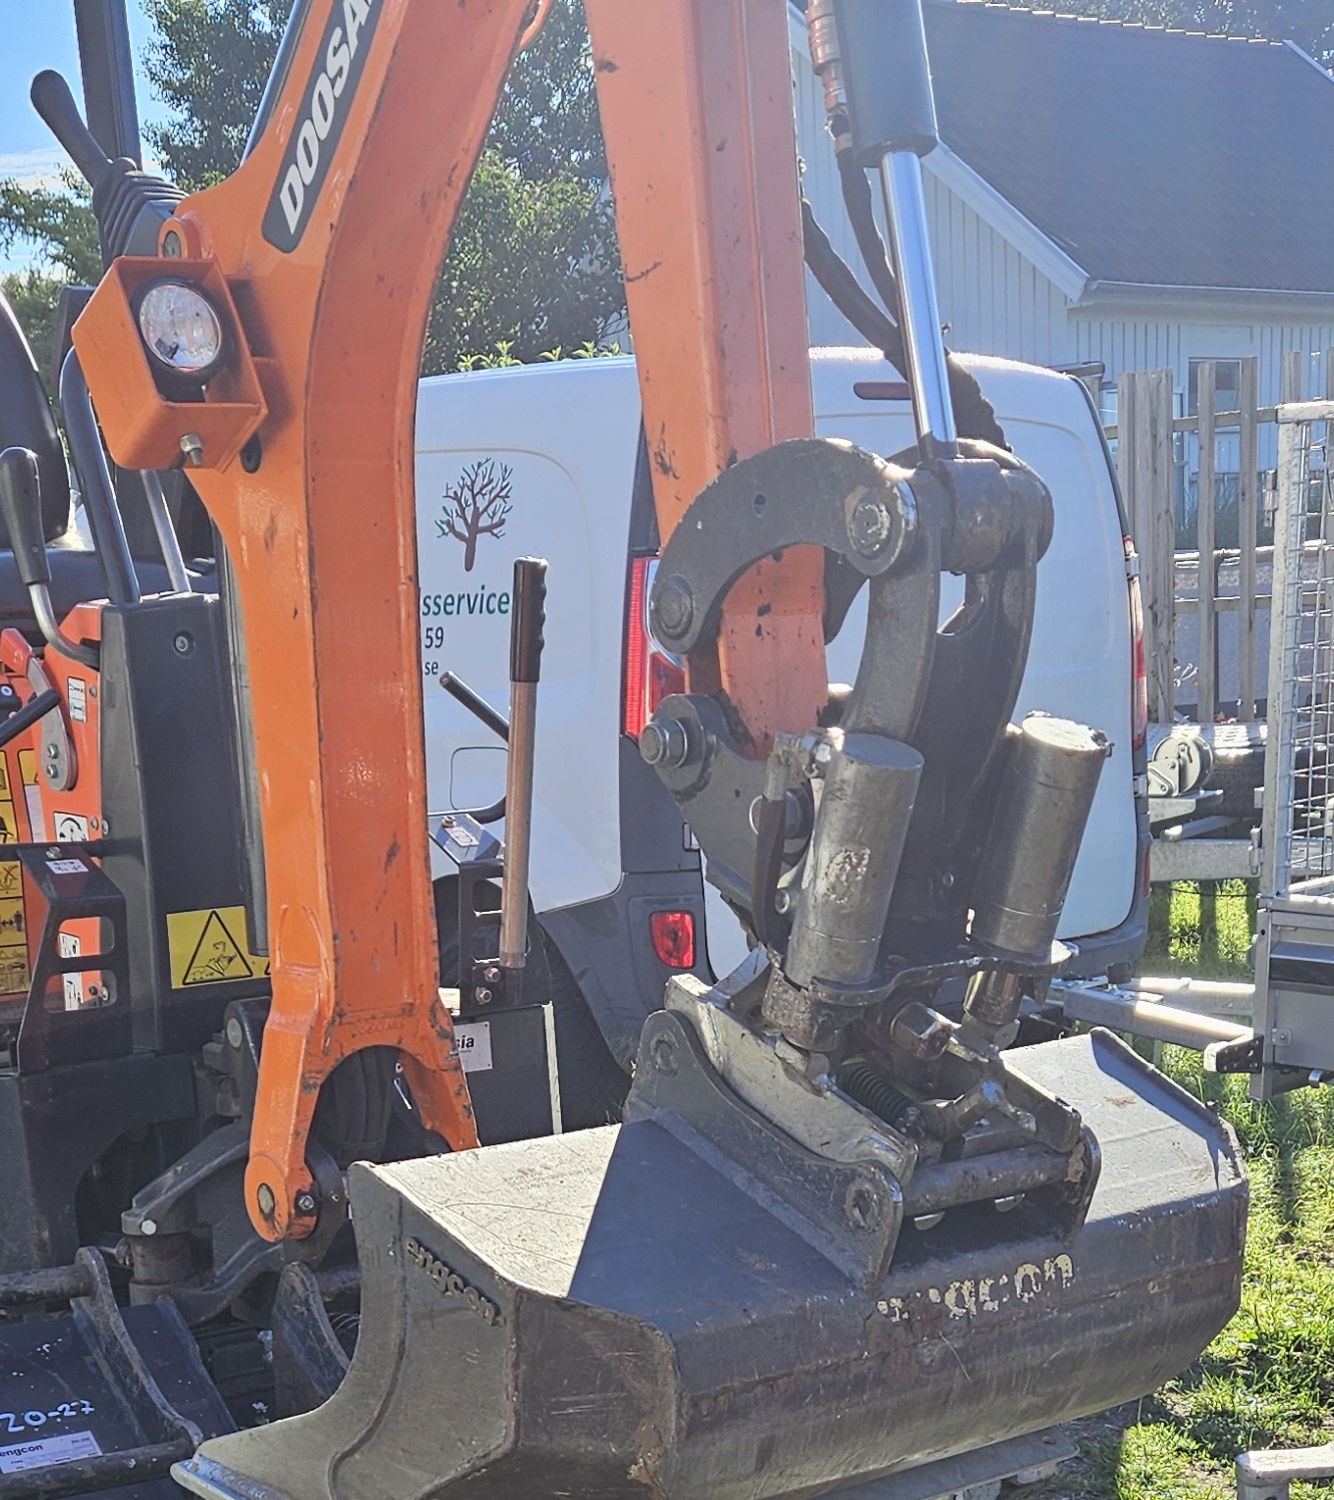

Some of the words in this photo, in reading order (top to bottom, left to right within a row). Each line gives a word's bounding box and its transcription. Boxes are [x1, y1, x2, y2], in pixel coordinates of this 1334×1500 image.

[279, 0, 371, 235] DOOSA
[422, 585, 510, 617] sservice
[424, 627, 444, 649] 59
[424, 661, 438, 675] se
[407, 1237, 496, 1326] engcon
[0, 1443, 44, 1458] engcon
